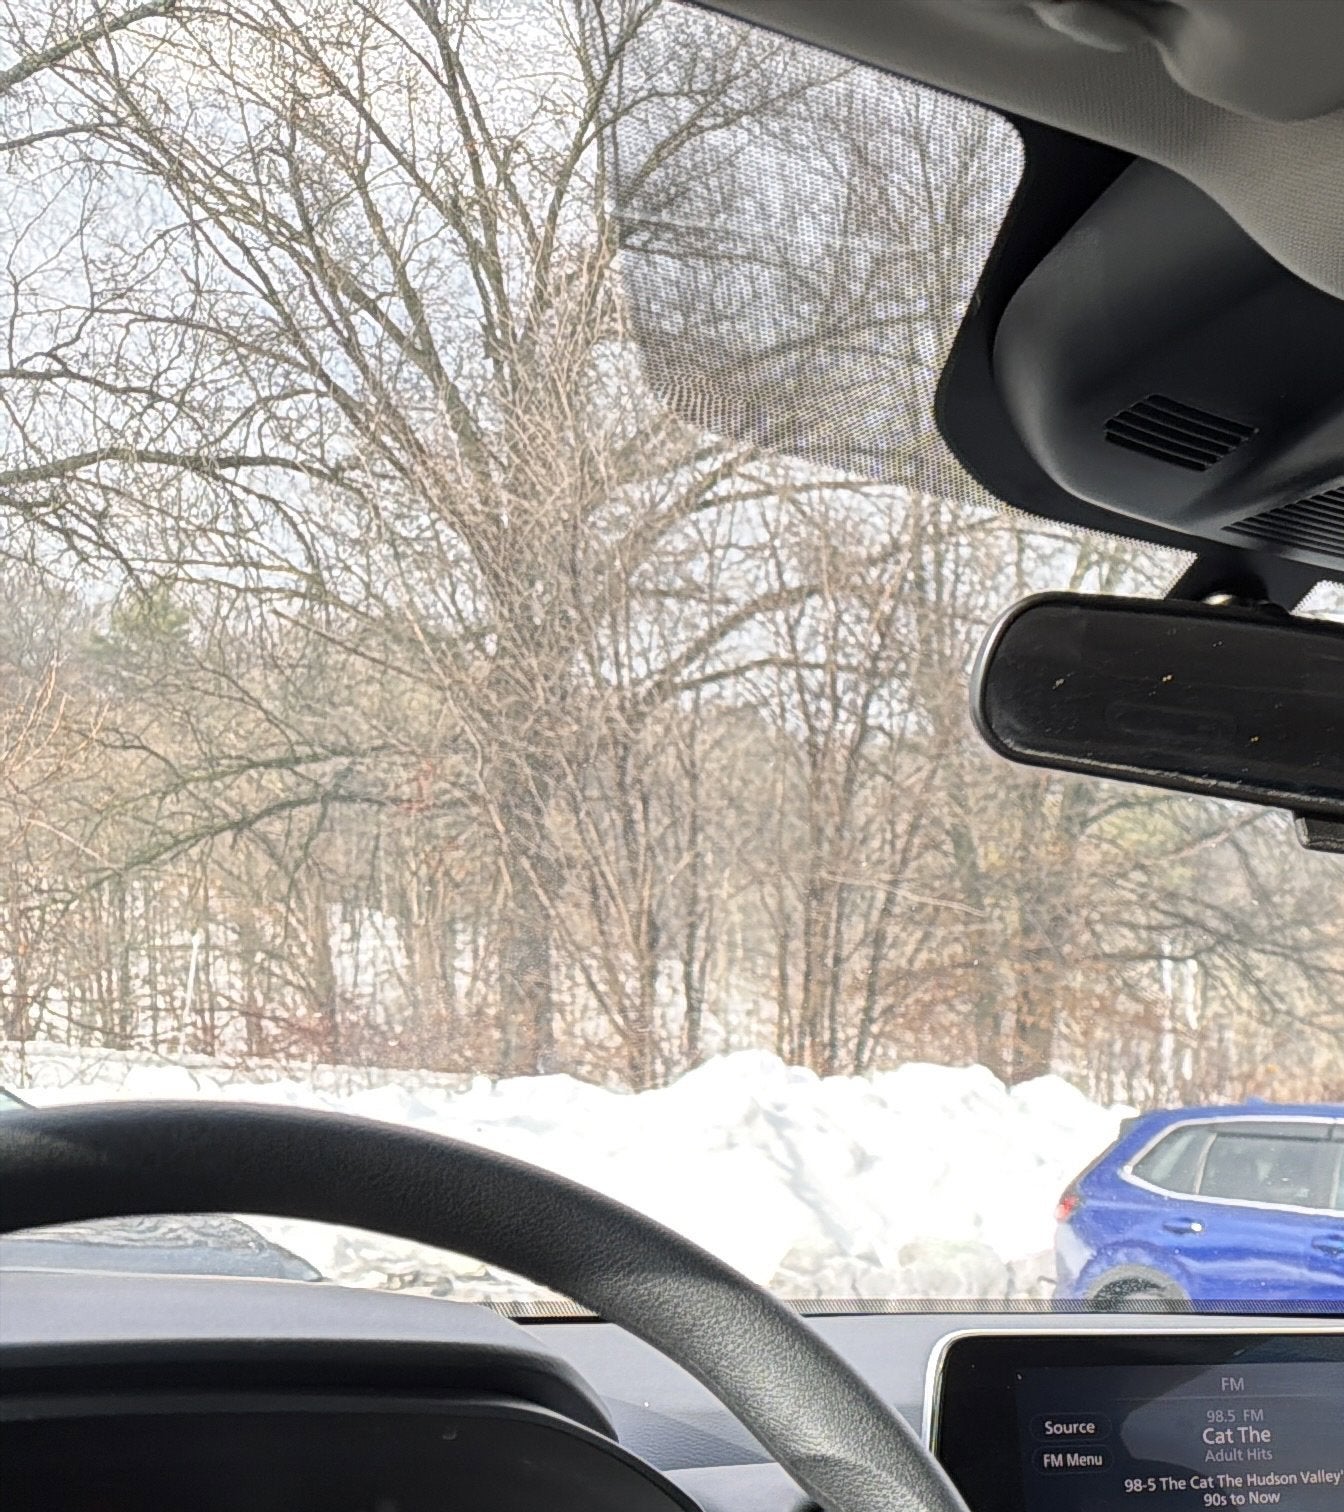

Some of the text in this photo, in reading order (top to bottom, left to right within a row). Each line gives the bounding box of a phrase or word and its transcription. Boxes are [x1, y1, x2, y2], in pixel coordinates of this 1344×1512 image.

[1221, 1377, 1245, 1391] FM
[1207, 1409, 1264, 1423] 98.5 FM
[1044, 1421, 1095, 1435] Source
[1202, 1426, 1271, 1445] Cat The
[1043, 1453, 1103, 1468] FM Menu
[1205, 1448, 1273, 1463] Adult Hits
[1124, 1478, 1157, 1493] 98-5
[1159, 1477, 1186, 1490] The
[1190, 1475, 1214, 1489] Cat
[1217, 1474, 1243, 1488] The
[1247, 1471, 1298, 1487] Hudson
[1204, 1491, 1281, 1507] 90s to Now
